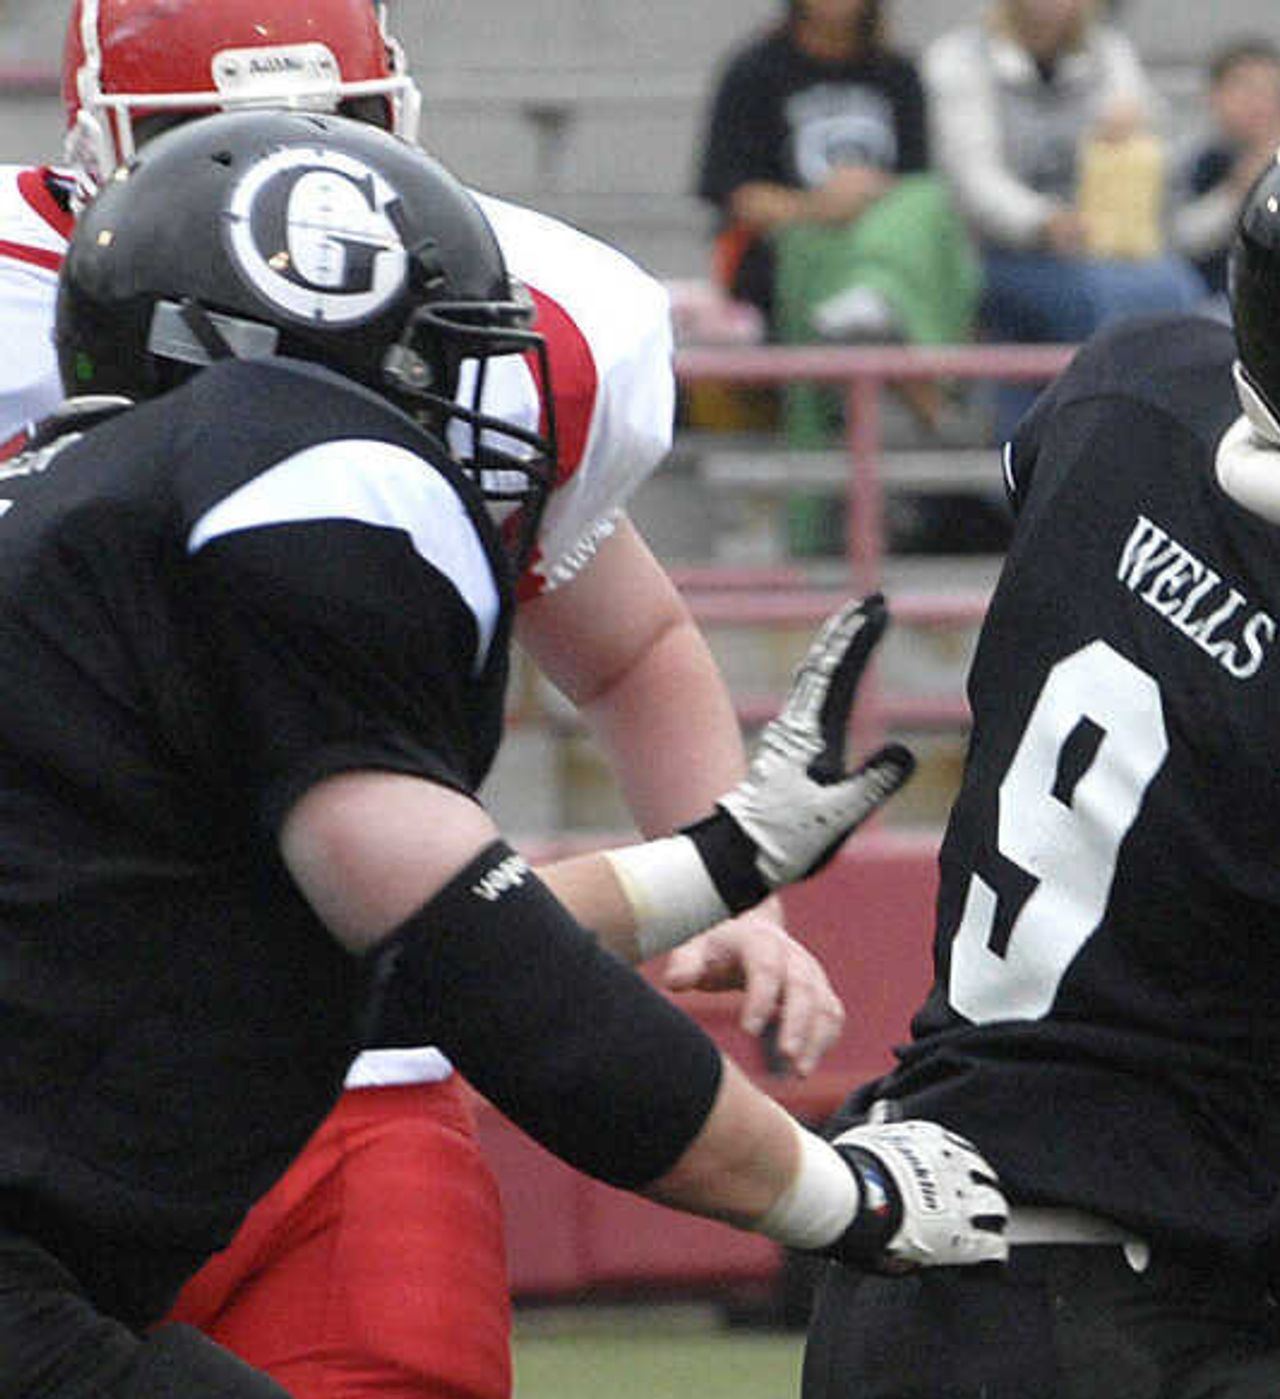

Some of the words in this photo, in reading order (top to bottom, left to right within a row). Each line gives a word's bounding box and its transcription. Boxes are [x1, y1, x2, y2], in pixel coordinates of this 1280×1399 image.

[250, 164, 394, 293] G
[1116, 514, 1276, 679] WELLS
[948, 638, 1171, 1027] 9
